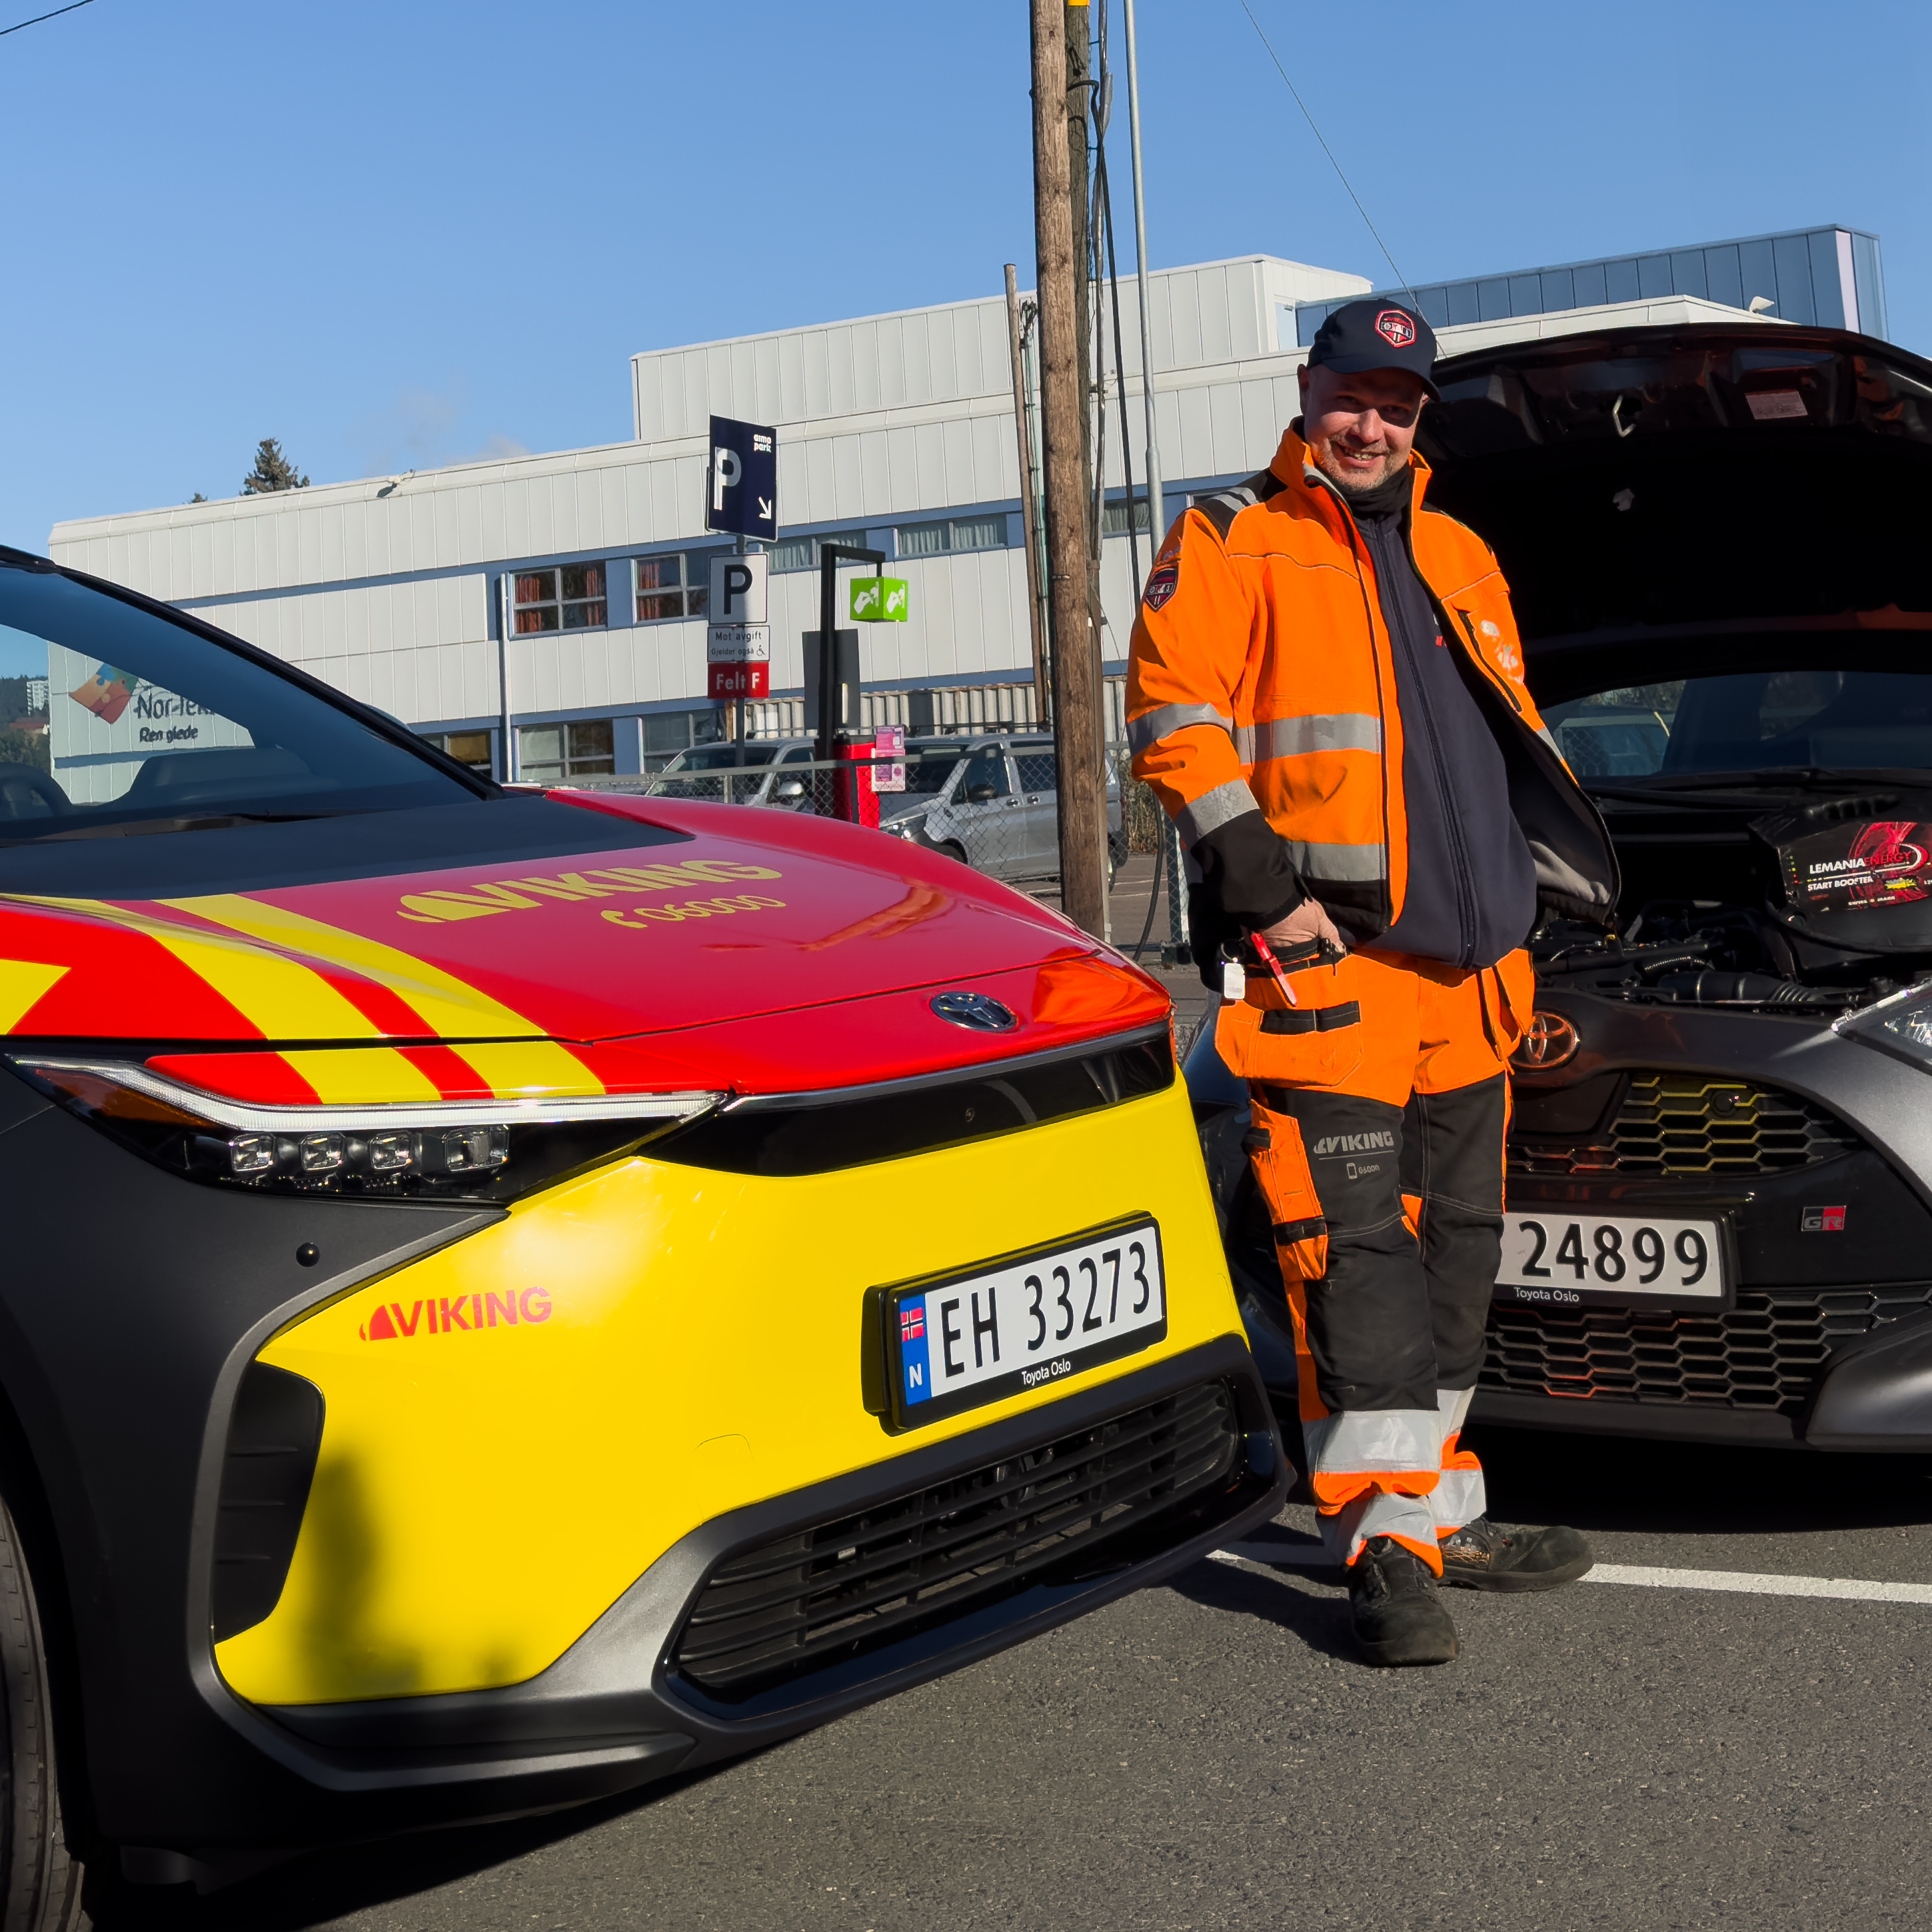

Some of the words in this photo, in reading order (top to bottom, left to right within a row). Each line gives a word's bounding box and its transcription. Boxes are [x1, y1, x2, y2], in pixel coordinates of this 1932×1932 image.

[754, 434, 771, 444] aimo
[754, 442, 771, 453] park
[714, 447, 742, 510] P
[724, 564, 753, 614] P
[715, 632, 731, 640] Mot
[736, 630, 761, 642] avgift
[711, 648, 735, 656] Gjelder
[716, 671, 746, 690] Felt
[752, 672, 760, 689] F
[139, 726, 163, 742] Ren
[167, 724, 198, 743] glede
[471, 860, 782, 909] VIKING
[1807, 881, 1833, 892] START
[1835, 876, 1873, 887] BOOSTER
[633, 895, 786, 922] 06000
[1326, 1131, 1394, 1153] VIKING
[1804, 1215, 1842, 1229] GR
[1519, 1220, 1708, 1286] 24899
[1514, 1286, 1551, 1302] Toyota
[390, 1286, 552, 1337] VIKING
[940, 1287, 1001, 1378] EH
[1024, 1241, 1150, 1351] 33273
[909, 1362, 922, 1388] N
[1021, 1366, 1050, 1386] Toyota
[1051, 1358, 1071, 1376] Oslo
